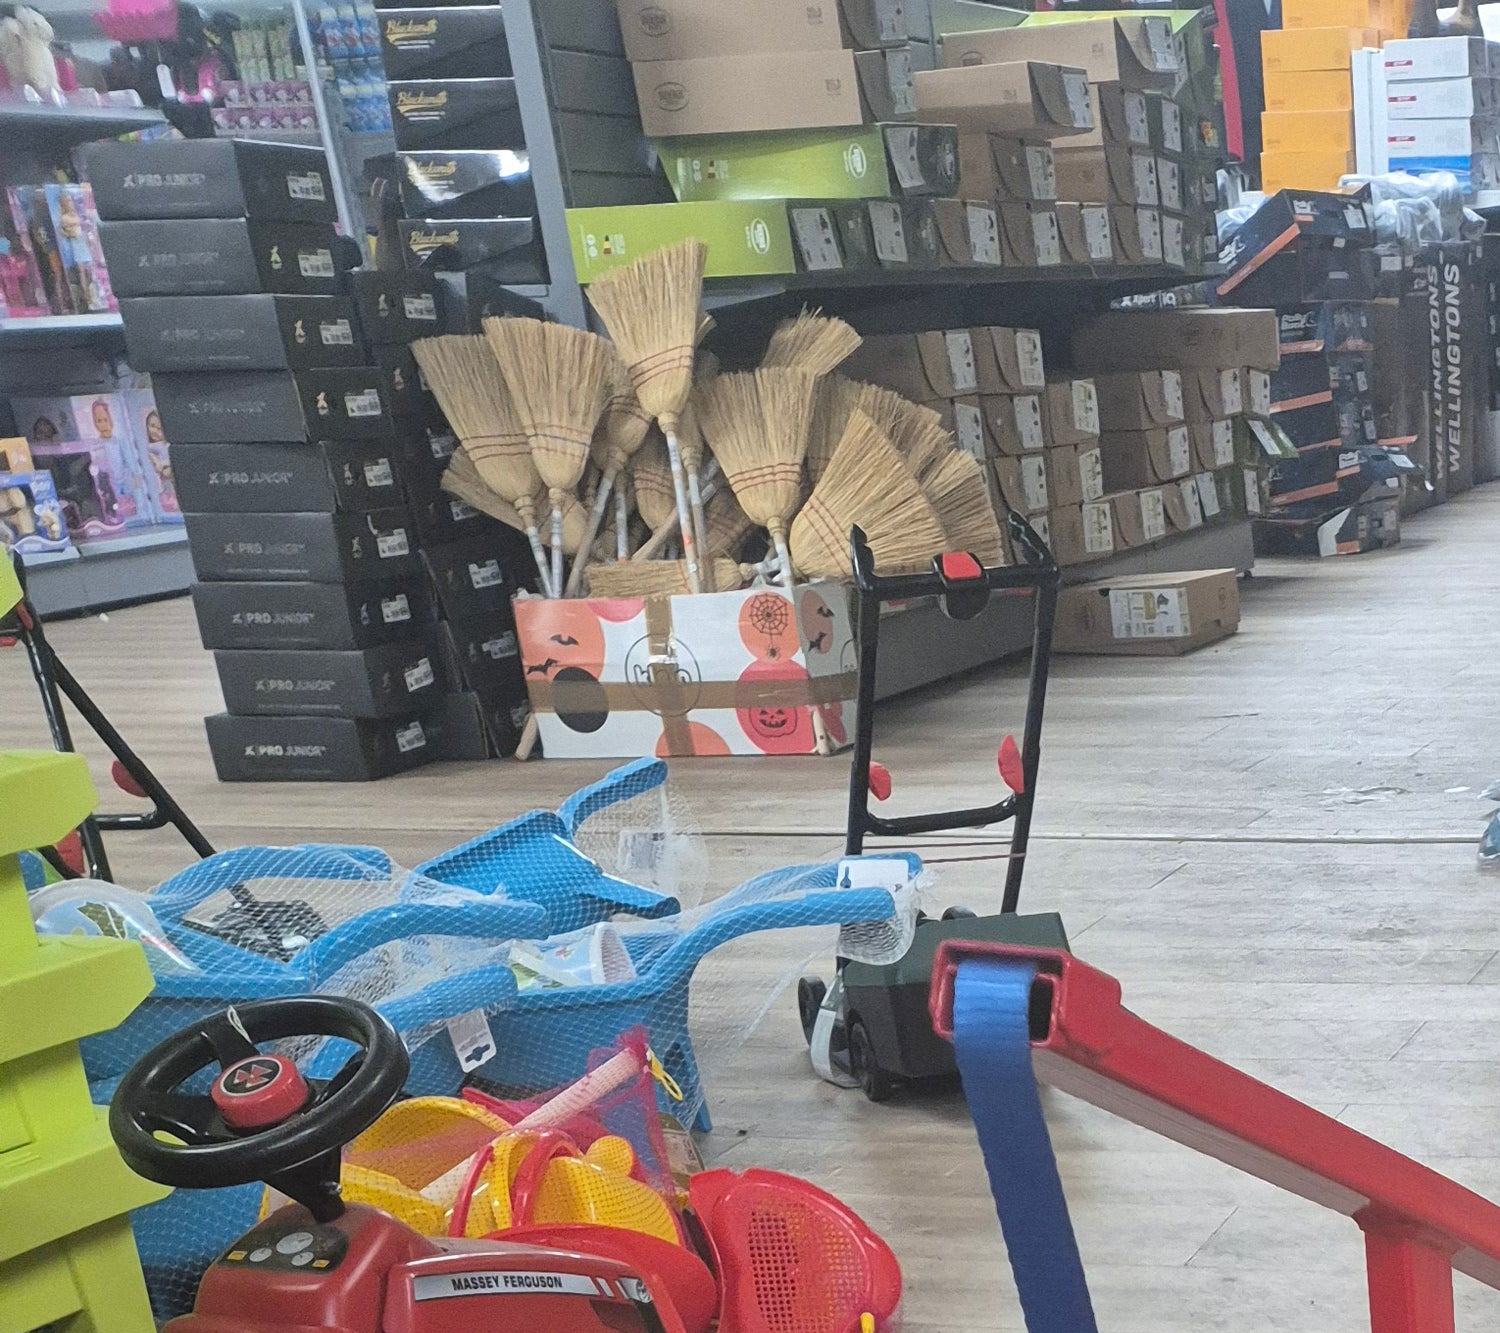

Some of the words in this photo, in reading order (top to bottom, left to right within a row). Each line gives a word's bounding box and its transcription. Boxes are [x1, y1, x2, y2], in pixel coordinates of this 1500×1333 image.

[1426, 264, 1444, 481] WELLINGTONS
[1443, 262, 1462, 473] WELLINGTONS
[246, 611, 272, 625] PRO
[258, 744, 284, 757] PRO
[451, 1276, 499, 1291] MASSEY
[503, 1275, 563, 1289] FERGUSON
